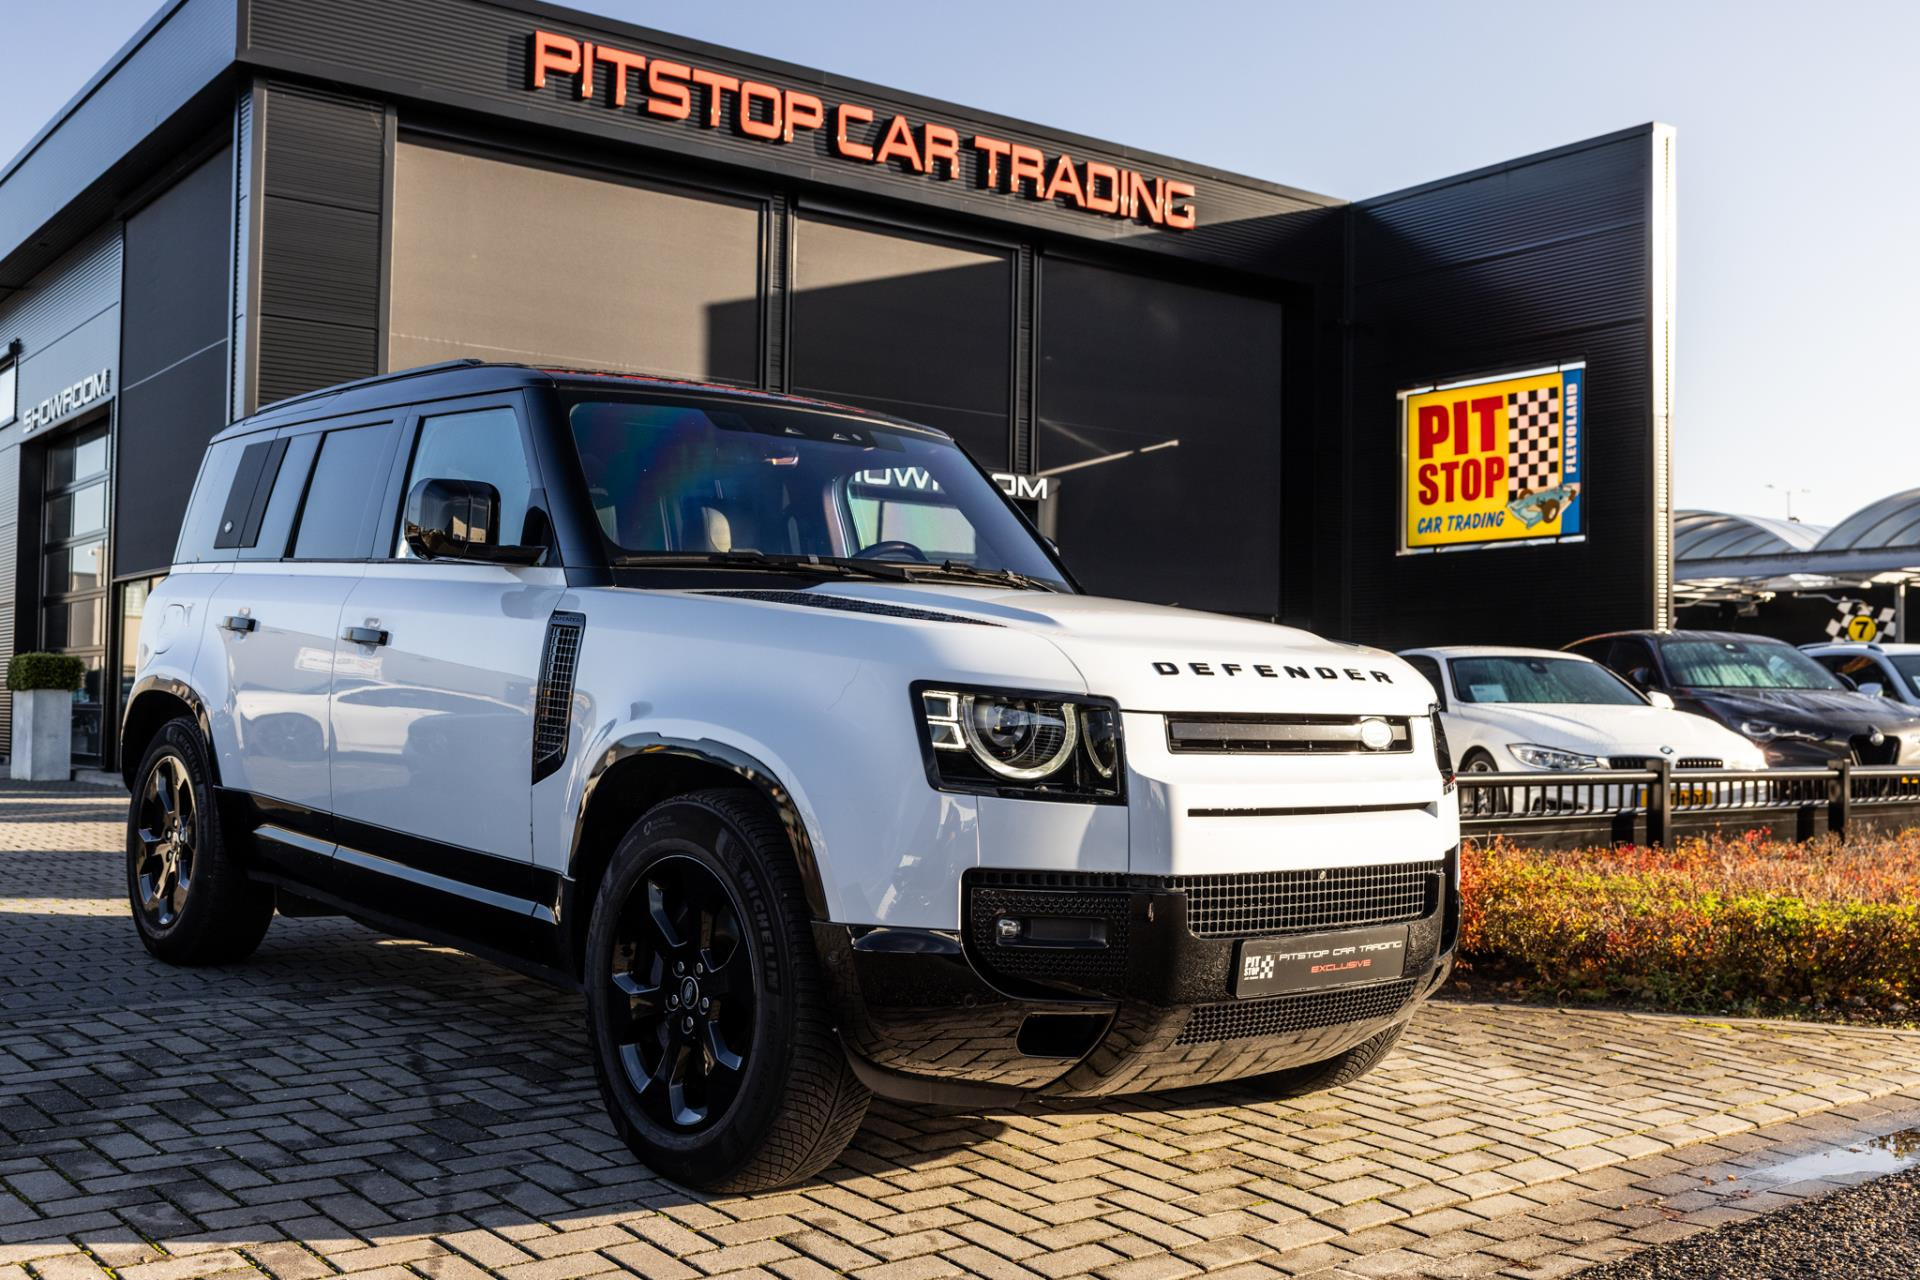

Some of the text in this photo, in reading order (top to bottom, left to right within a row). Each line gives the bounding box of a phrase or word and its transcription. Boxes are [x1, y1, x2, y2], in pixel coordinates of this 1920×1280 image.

[533, 29, 1197, 230] PITSTOP CAR TRADING
[23, 368, 108, 433] SHOWROOM
[1418, 395, 1504, 460] PIT
[1565, 383, 1578, 474] FLEVOLAND
[1418, 456, 1505, 506] STOP
[1417, 511, 1505, 535] CAR TRADING
[1855, 621, 1869, 639] 7
[1152, 662, 1394, 684] DEFENDER
[740, 868, 779, 990] MICHELIN
[1244, 955, 1261, 968] PIT
[1279, 940, 1403, 962] PITSTOP CAR TRADING
[1311, 959, 1372, 973] EXCLUSIVE
